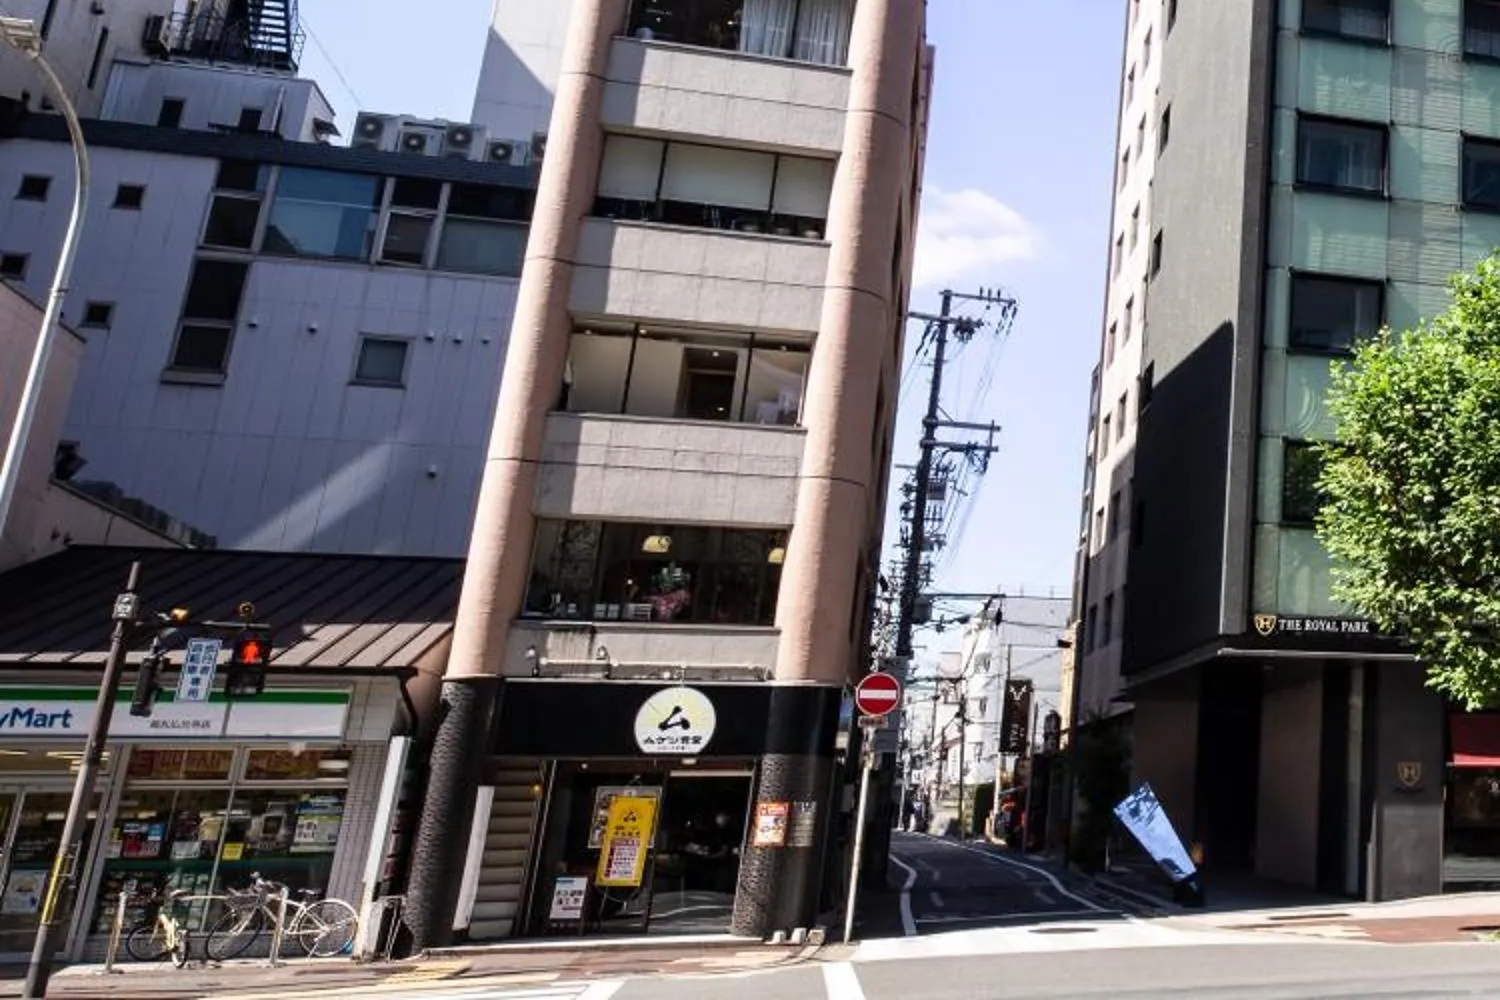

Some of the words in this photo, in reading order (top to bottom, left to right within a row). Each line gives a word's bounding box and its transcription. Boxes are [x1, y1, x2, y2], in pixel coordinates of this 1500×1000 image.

[1278, 619, 1301, 631] THE
[1305, 619, 1339, 632] ROYAL
[1341, 621, 1369, 633] PARK
